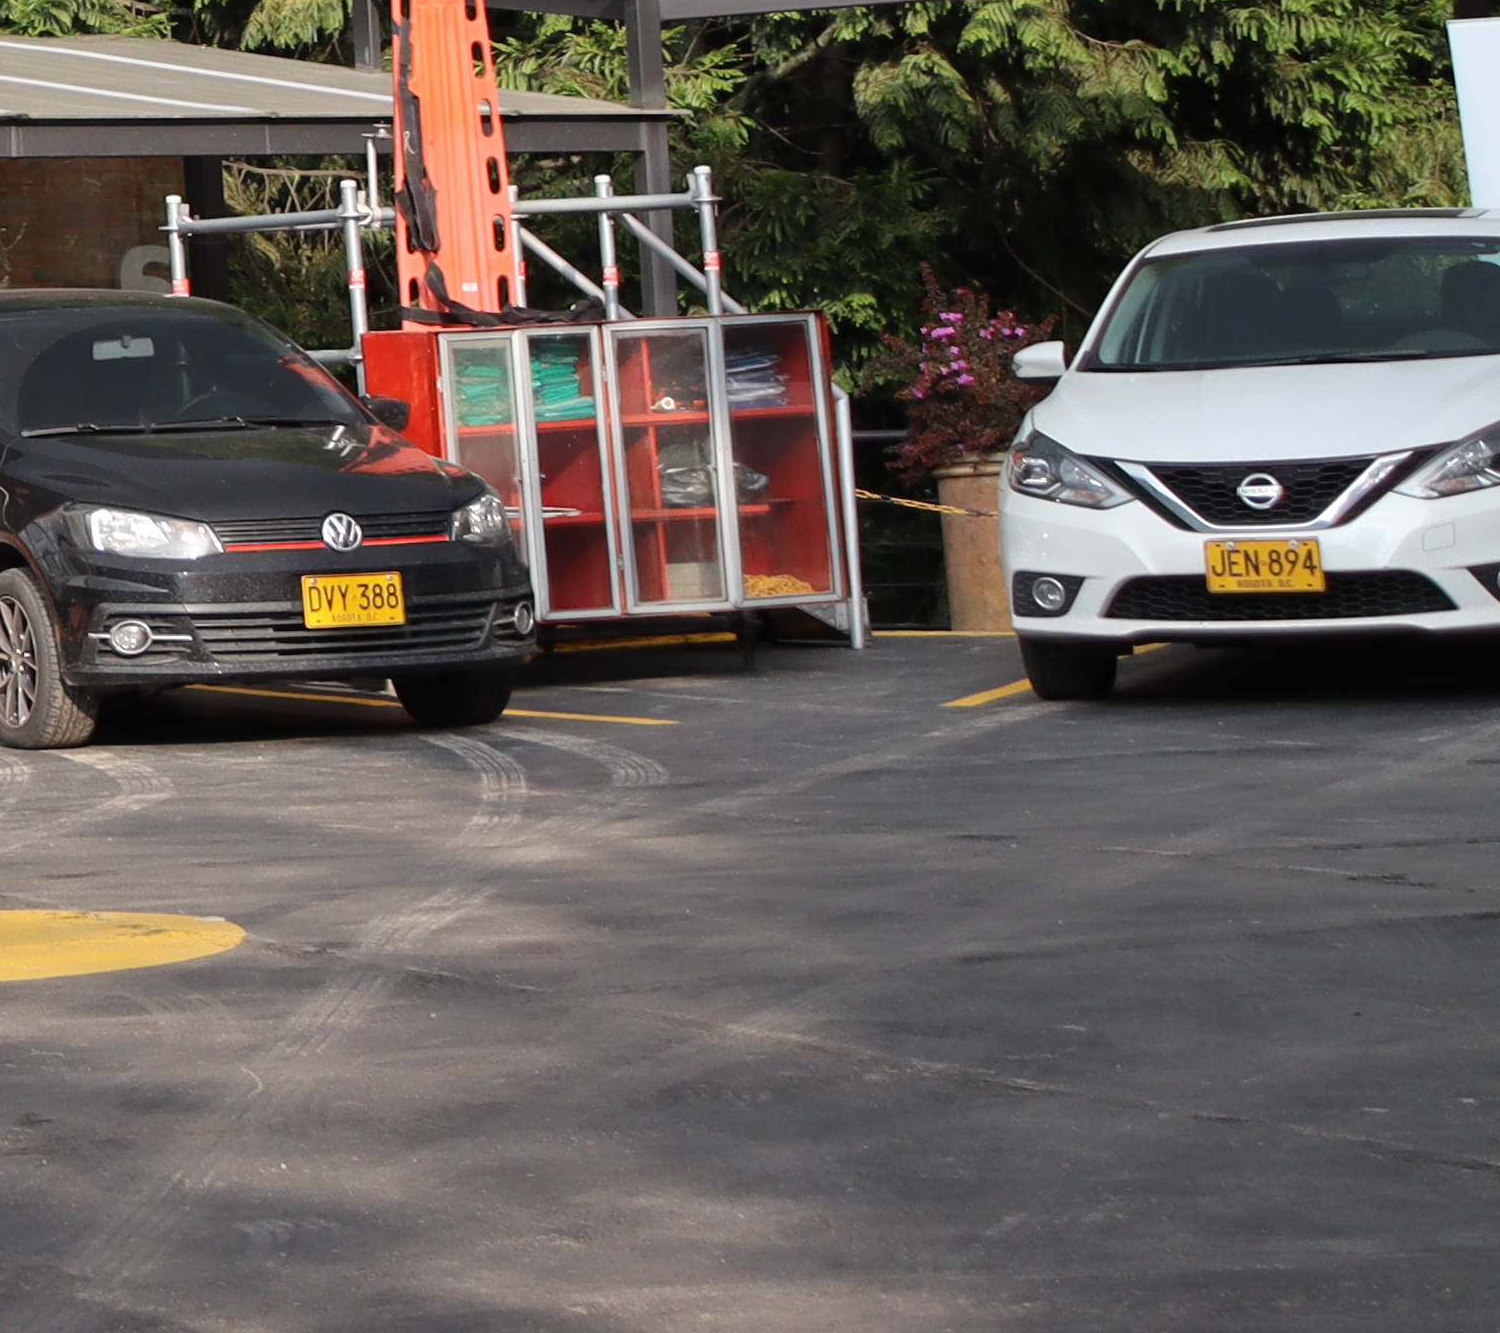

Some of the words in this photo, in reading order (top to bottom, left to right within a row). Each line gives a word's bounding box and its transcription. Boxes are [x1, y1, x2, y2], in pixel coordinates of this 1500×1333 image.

[1211, 549, 1261, 577] JEN
[1268, 548, 1317, 577] 894
[308, 584, 349, 612] DVY
[357, 583, 399, 610] 388
